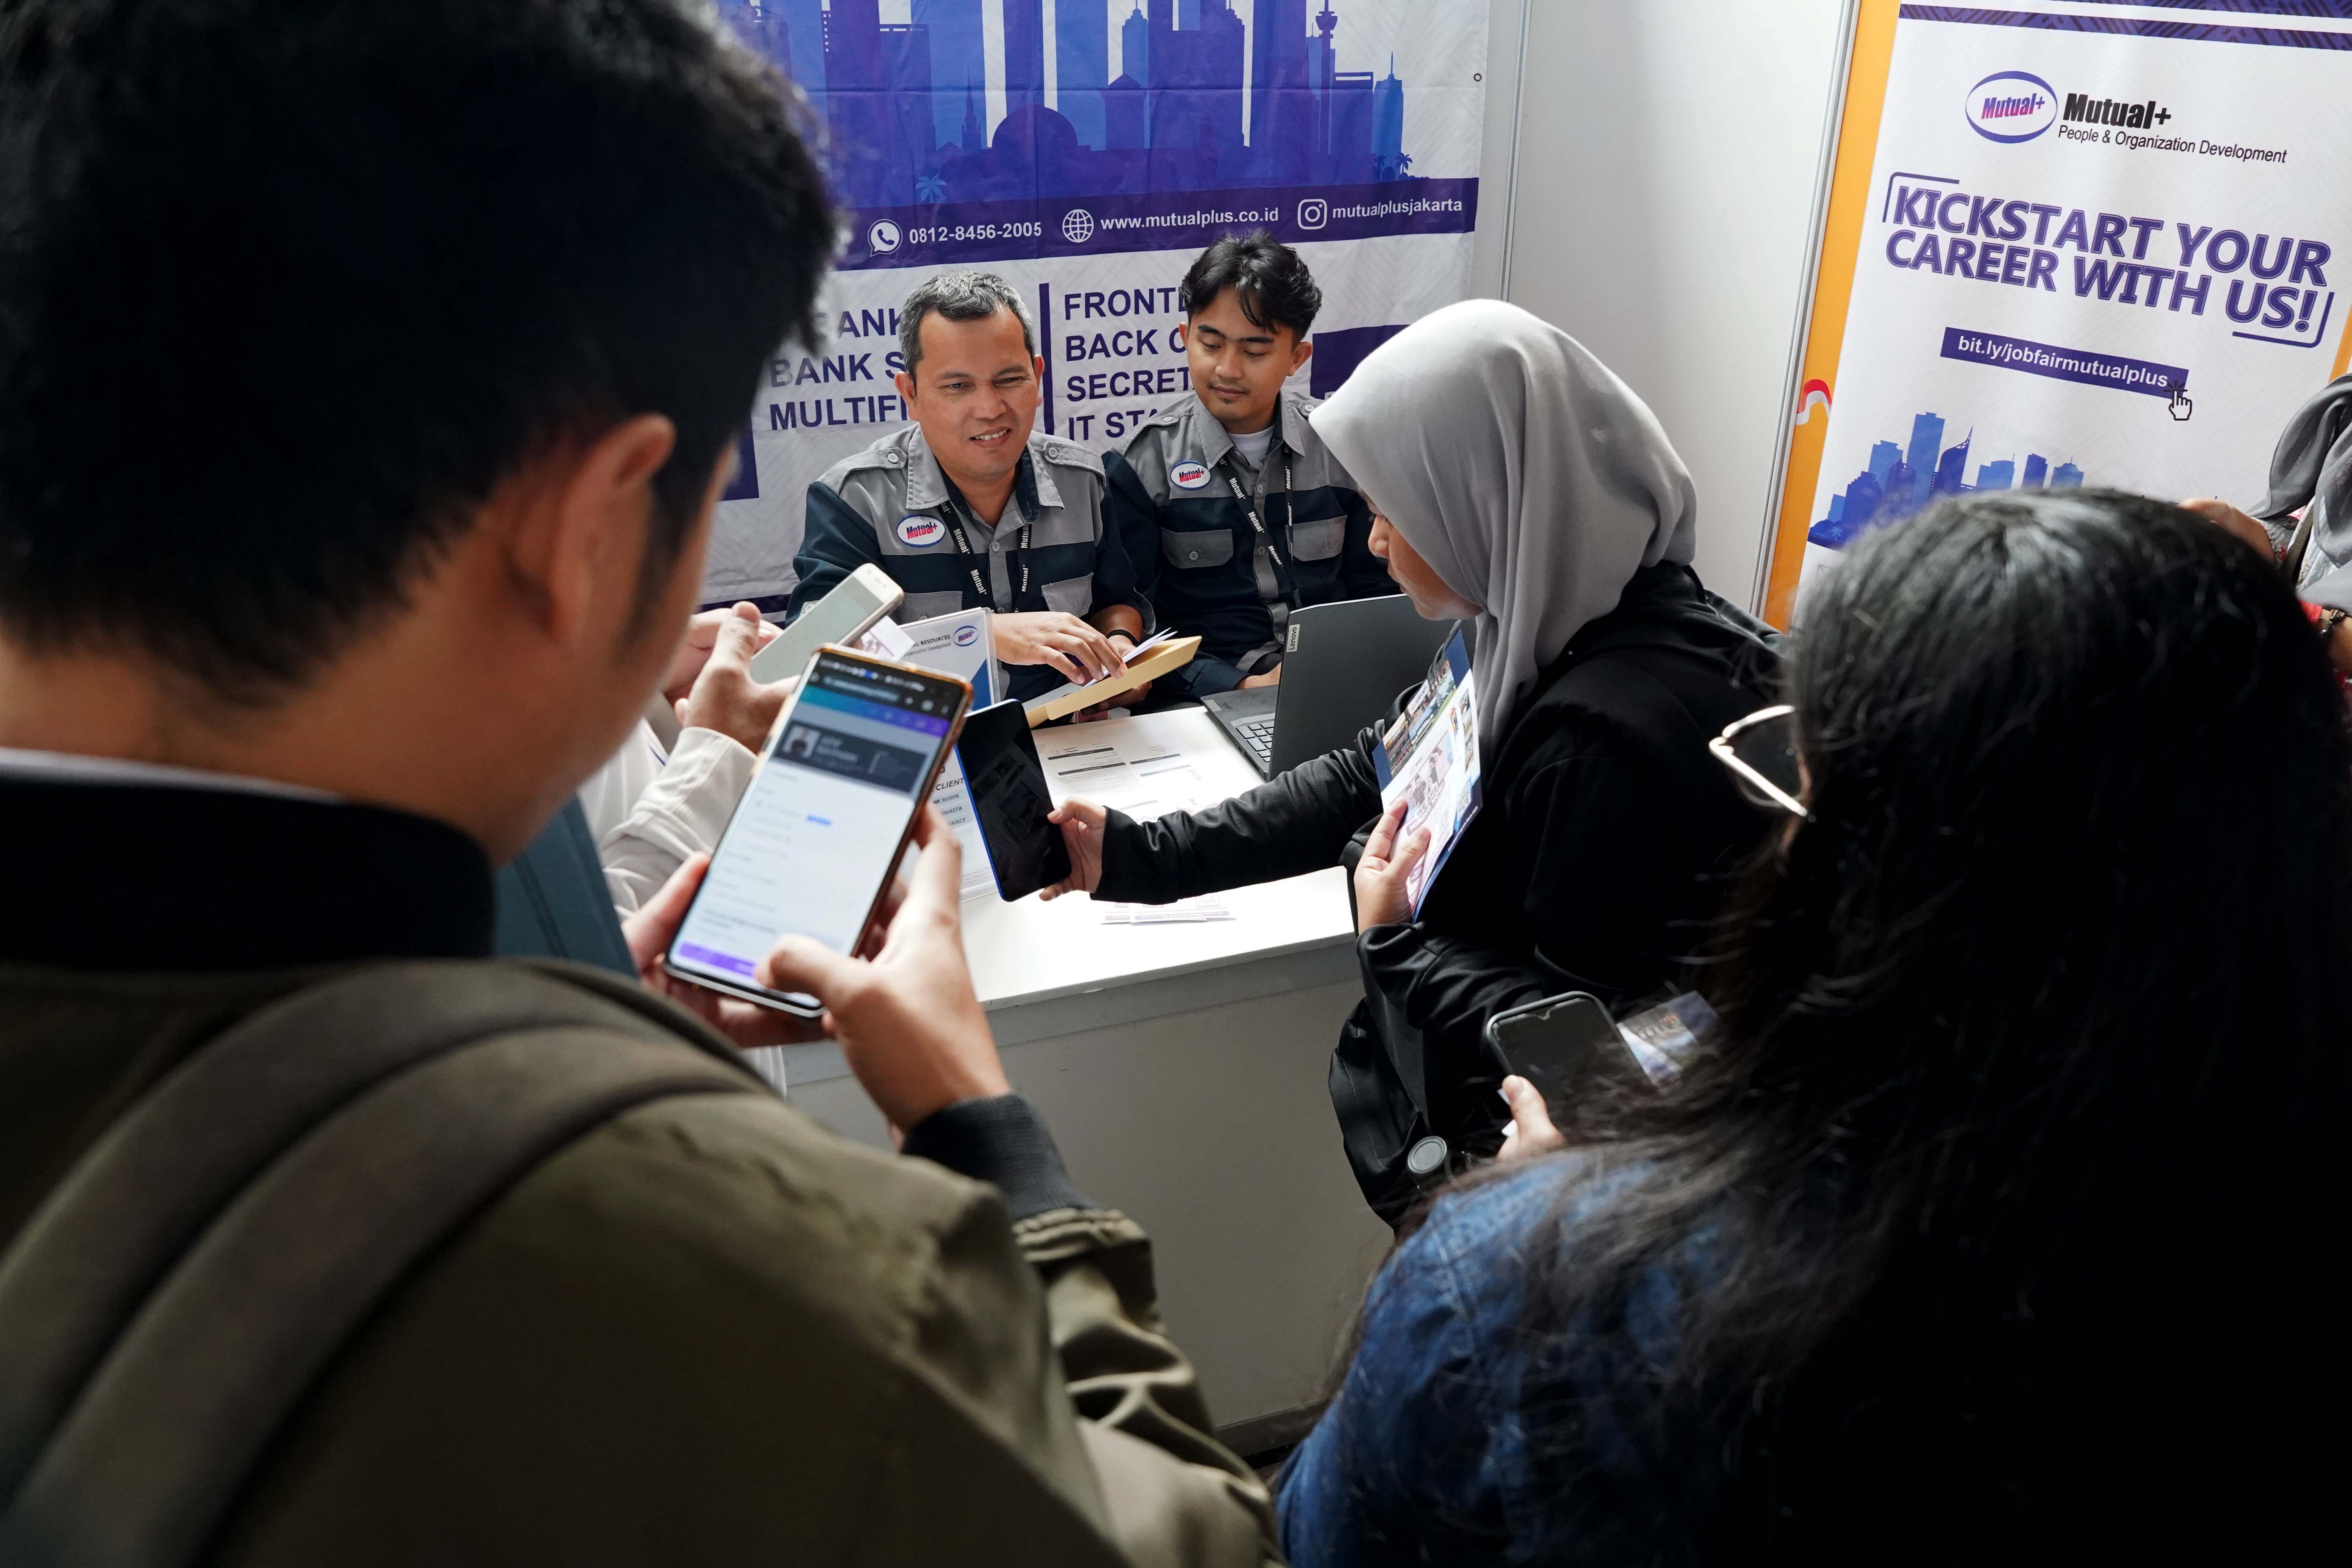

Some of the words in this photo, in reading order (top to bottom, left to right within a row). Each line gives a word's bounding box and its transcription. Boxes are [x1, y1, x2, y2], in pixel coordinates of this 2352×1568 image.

[1981, 93, 2045, 120] Mutual+
[2062, 93, 2172, 129] Mutual+
[2058, 125, 2098, 144] People
[2102, 130, 2111, 143] &
[2115, 131, 2195, 152] Organization
[2199, 140, 2288, 163] Development
[1100, 207, 1279, 229] www.mutualplus.co.id
[1333, 198, 1462, 218] mutualplusjakarta
[909, 221, 1042, 244] 0812-8456-2005
[1893, 185, 2163, 261] KICKSTART
[2176, 223, 2331, 287] YOUR
[1886, 230, 2058, 292] CAREER
[2074, 256, 2210, 315] WITH
[2226, 278, 2318, 332] US!
[1066, 329, 1158, 361] BACK
[769, 353, 873, 388] BANK
[885, 352, 907, 379] S
[1958, 335, 2168, 388] bit.ly/jobfairmutualplus
[1067, 367, 1194, 402] SECRET
[769, 395, 907, 430] MULTIFI
[1069, 415, 1095, 441] IT
[1179, 468, 1204, 483] Mutual+
[1229, 477, 1246, 499] Mutual+
[906, 522, 937, 539] Mutual+
[1248, 511, 1265, 534] Mutual+
[953, 528, 970, 555] Mutual+
[1021, 524, 1029, 548] Mutual
[971, 569, 987, 595] Mutual+
[921, 634, 951, 646] RESOURCES
[927, 642, 951, 652] Development
[958, 630, 975, 642] Mutual+
[1289, 627, 1298, 650] Lenovo
[942, 793, 959, 802] BUMN
[941, 806, 962, 815] SWASTA
